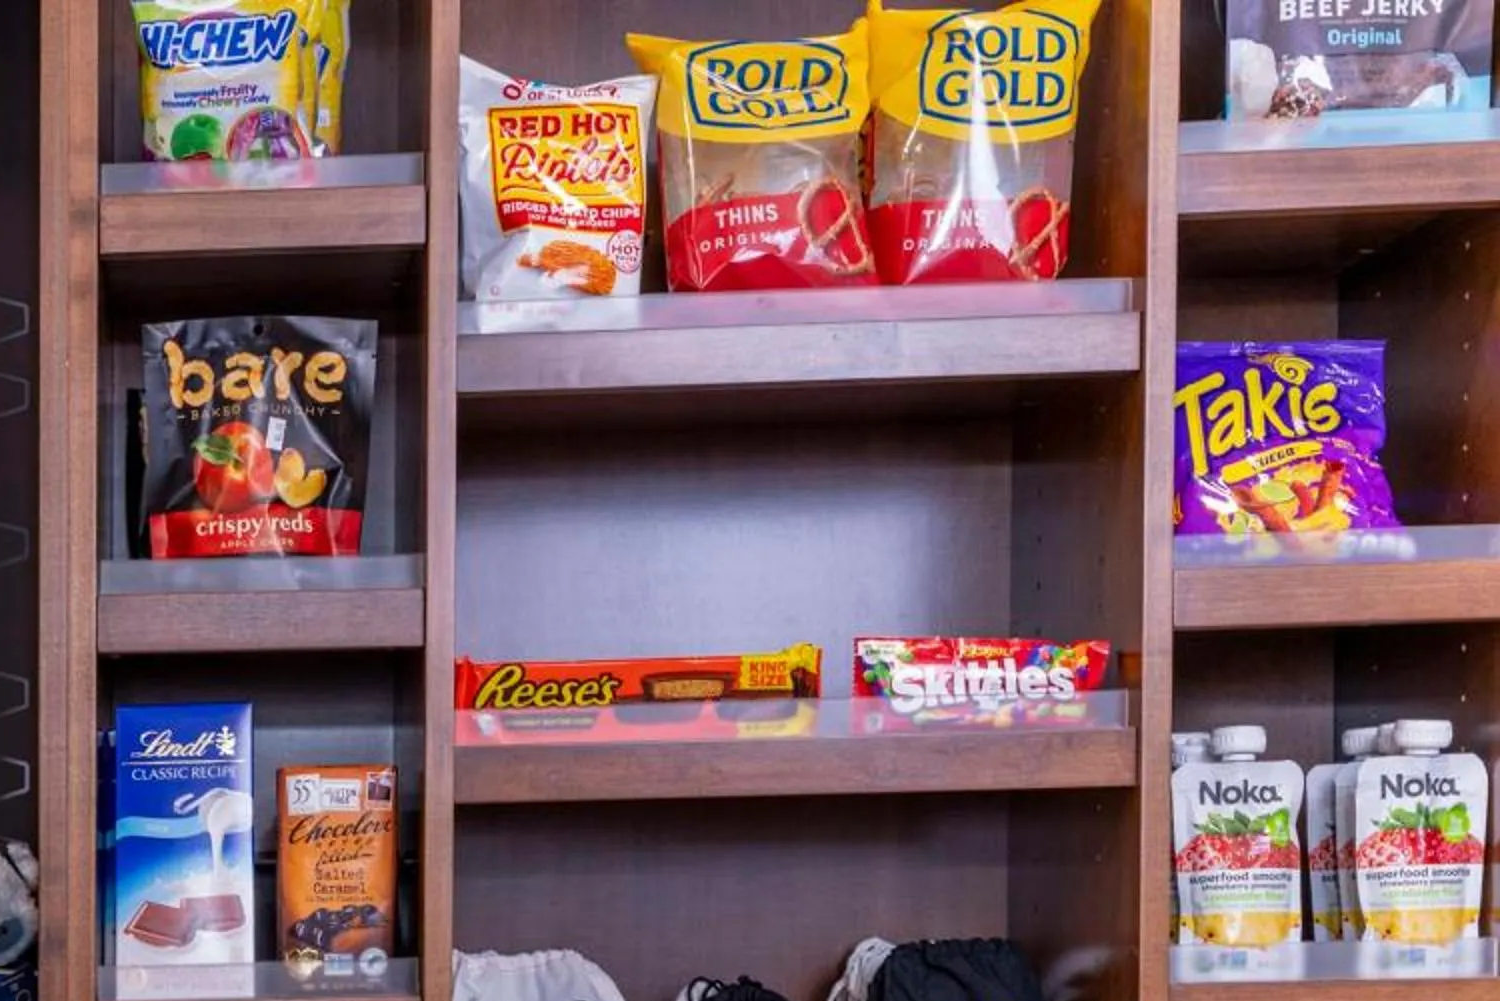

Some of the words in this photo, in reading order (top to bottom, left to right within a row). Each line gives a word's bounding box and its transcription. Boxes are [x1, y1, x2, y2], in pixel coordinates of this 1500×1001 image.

[1279, 0, 1349, 21] BEEF
[1360, 0, 1444, 17] JERKY
[139, 9, 297, 69] HI-CHEW
[945, 26, 1067, 64] ROLD
[1327, 28, 1402, 47] Original
[935, 70, 1065, 107] GOLD
[500, 115, 561, 138] RED
[572, 112, 632, 136] HOT
[601, 206, 641, 219] CHIPS
[715, 203, 779, 228] THINS
[612, 246, 640, 255] HOT
[163, 339, 348, 409] bare
[1173, 356, 1341, 477] Takis
[195, 514, 265, 538] crispy
[270, 513, 313, 533] reds
[749, 661, 787, 673] KING
[475, 663, 621, 709] Reese's
[749, 674, 787, 687] SIZE
[890, 658, 1076, 714] Skittles
[138, 729, 216, 758] Lindt
[131, 766, 190, 781] CLASSIC
[1381, 773, 1460, 800] Noka
[1199, 779, 1282, 805] Noka
